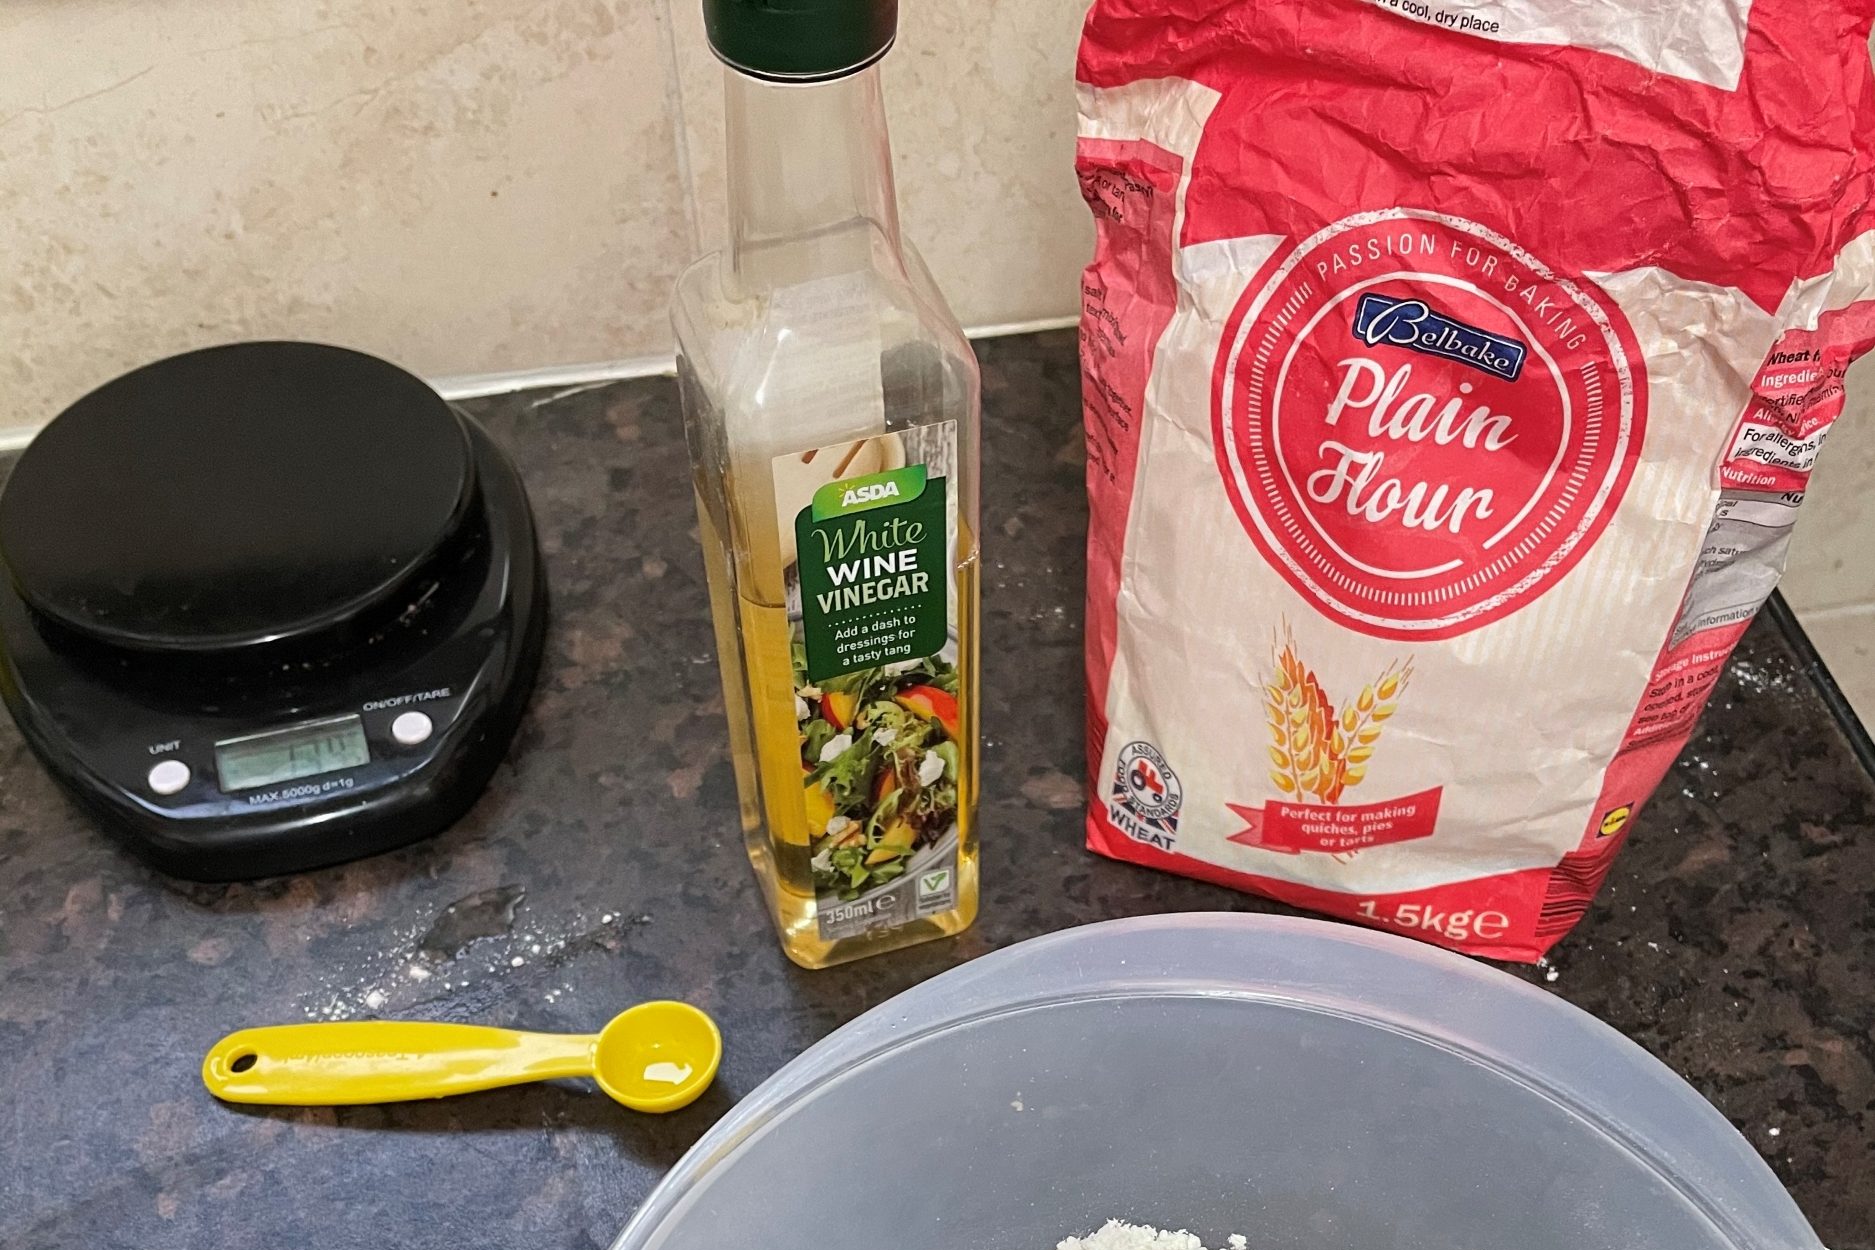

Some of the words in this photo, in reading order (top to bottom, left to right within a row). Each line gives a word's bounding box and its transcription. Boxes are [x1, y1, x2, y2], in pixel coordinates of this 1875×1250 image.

[1402, 0, 1431, 21] cool,
[1435, 10, 1459, 27] dry
[1460, 15, 1499, 33] place
[1317, 233, 1436, 281] PASSION
[1451, 240, 1498, 278] FOR
[1504, 274, 1587, 350] BAKING
[1366, 301, 1510, 372] Belbake
[1325, 357, 1519, 451] Plain
[1743, 428, 1764, 442] For
[1307, 440, 1494, 533] Flour
[1720, 466, 1776, 486] Nutrition
[842, 482, 899, 508] ASDA
[811, 517, 927, 563] White
[827, 548, 918, 587] WINE
[817, 571, 929, 614] VINEGAR
[834, 625, 858, 641] Add
[861, 626, 869, 635] a
[872, 617, 901, 633] dash
[904, 615, 917, 625] to
[837, 633, 895, 654] dressings
[898, 628, 916, 640] for
[842, 657, 850, 666] a
[853, 649, 881, 666] tasty
[884, 644, 911, 657] tang
[362, 687, 450, 712] ON/OFF/TARE
[149, 740, 181, 755] UNIT
[1280, 806, 1331, 823] Perfect
[1336, 807, 1358, 823] for
[1361, 803, 1417, 822] making
[1110, 804, 1176, 851] WHEAT
[1301, 820, 1358, 838] quiches,
[1363, 819, 1394, 836] pies
[1319, 836, 1336, 848] or
[1340, 834, 1375, 848] tarts
[826, 900, 874, 925] 350ml
